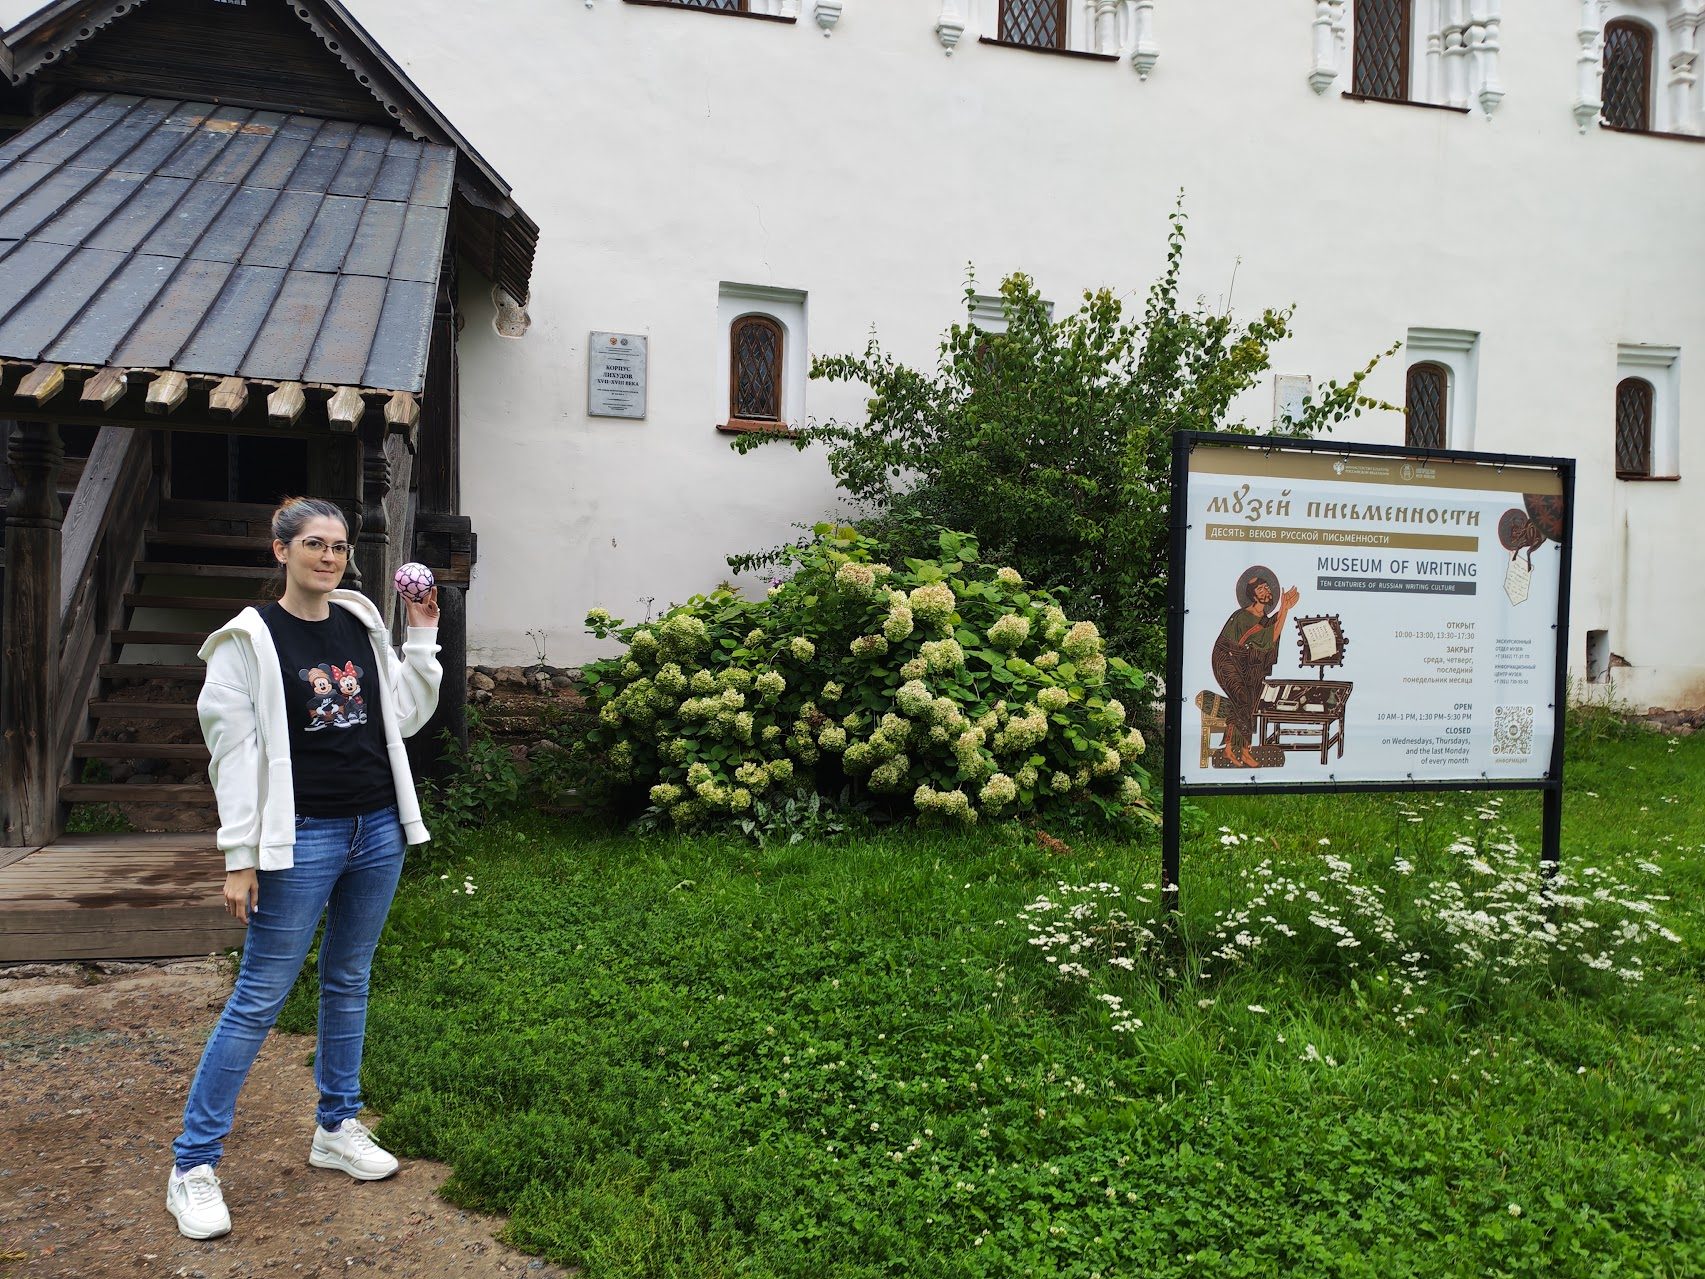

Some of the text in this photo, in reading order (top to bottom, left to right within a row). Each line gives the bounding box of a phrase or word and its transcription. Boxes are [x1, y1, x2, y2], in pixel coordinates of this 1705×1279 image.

[1306, 501, 1481, 527] ПИСЬМЕННОСТИ
[1211, 527, 1389, 544] ДЕСЯТЬ ВЕКОВ РУССКОЙ ПИСЬМЕННОСТИ
[1317, 556, 1477, 577] MUSEUM OF WRITING
[1334, 580, 1366, 588] CENTURIES
[1405, 583, 1429, 591] WRITING
[1405, 713, 1418, 721] PM,
[1392, 737, 1434, 746] Wednesdays,
[1435, 737, 1471, 745] Thursdays,
[1444, 747, 1470, 756] Monday
